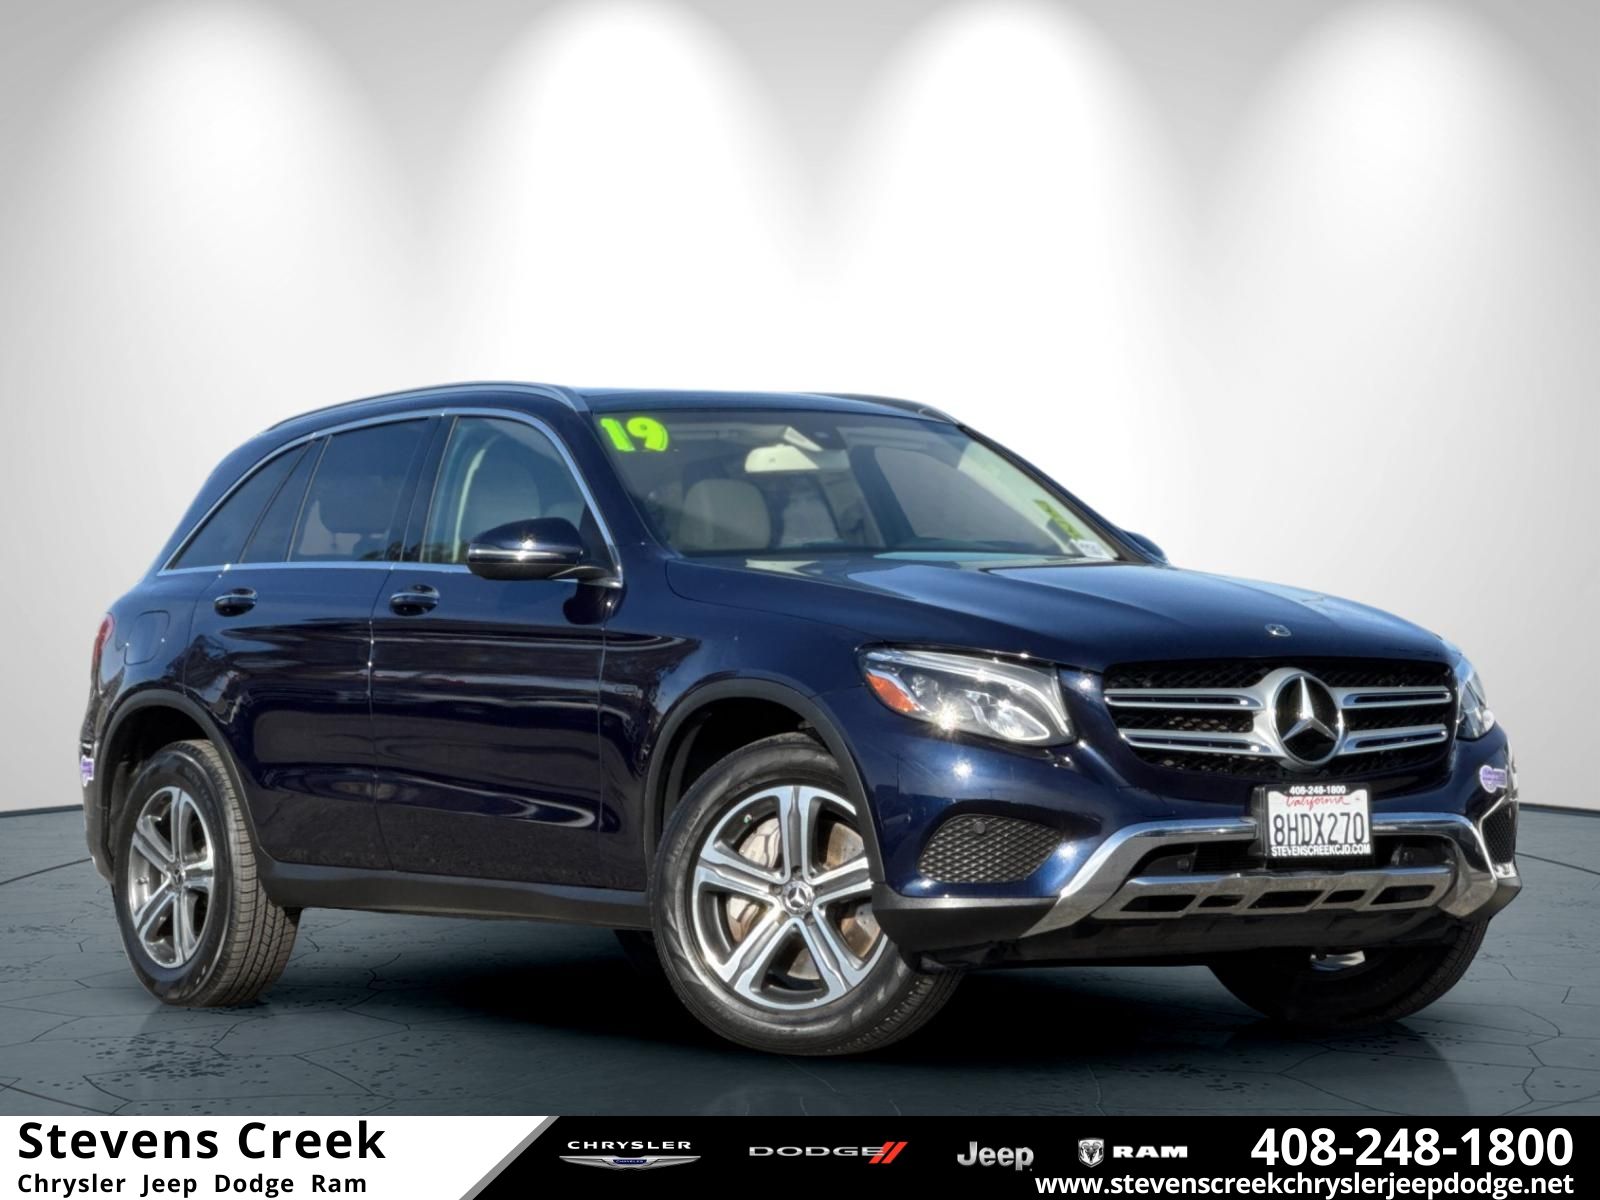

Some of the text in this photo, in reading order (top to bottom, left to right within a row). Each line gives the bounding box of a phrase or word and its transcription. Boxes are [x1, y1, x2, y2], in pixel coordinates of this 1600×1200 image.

[601, 416, 668, 451] 19
[1289, 785, 1346, 795] 408-248-1800
[1273, 811, 1365, 845] 8HDX270
[1271, 843, 1371, 857] STEVENSCREEKCJD.COM
